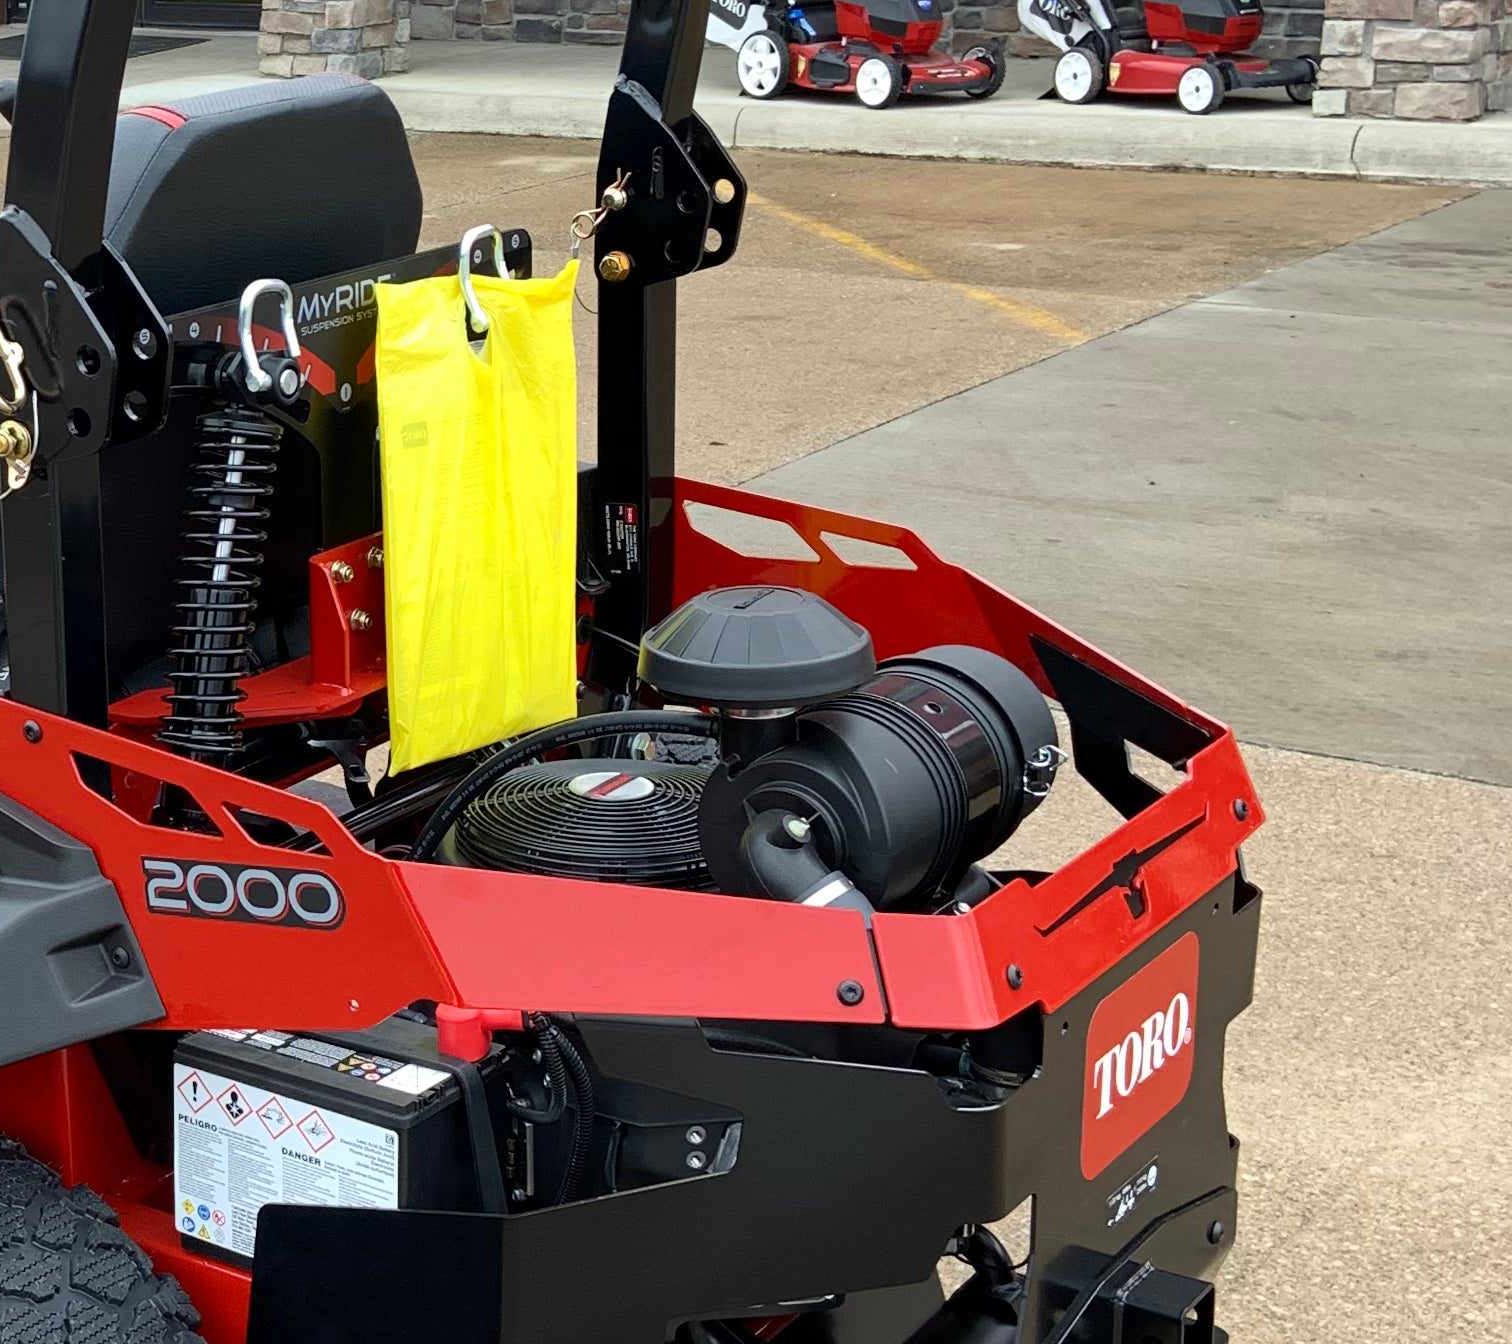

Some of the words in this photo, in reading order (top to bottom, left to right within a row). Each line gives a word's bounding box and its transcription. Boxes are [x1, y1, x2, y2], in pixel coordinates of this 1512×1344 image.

[300, 314, 354, 337] SUSPENSION
[356, 307, 377, 322] SYST
[144, 859, 341, 924] 2000
[1093, 992, 1190, 1120] TORO
[178, 1113, 218, 1132] PELIGRO
[281, 1147, 321, 1167] DANGER
